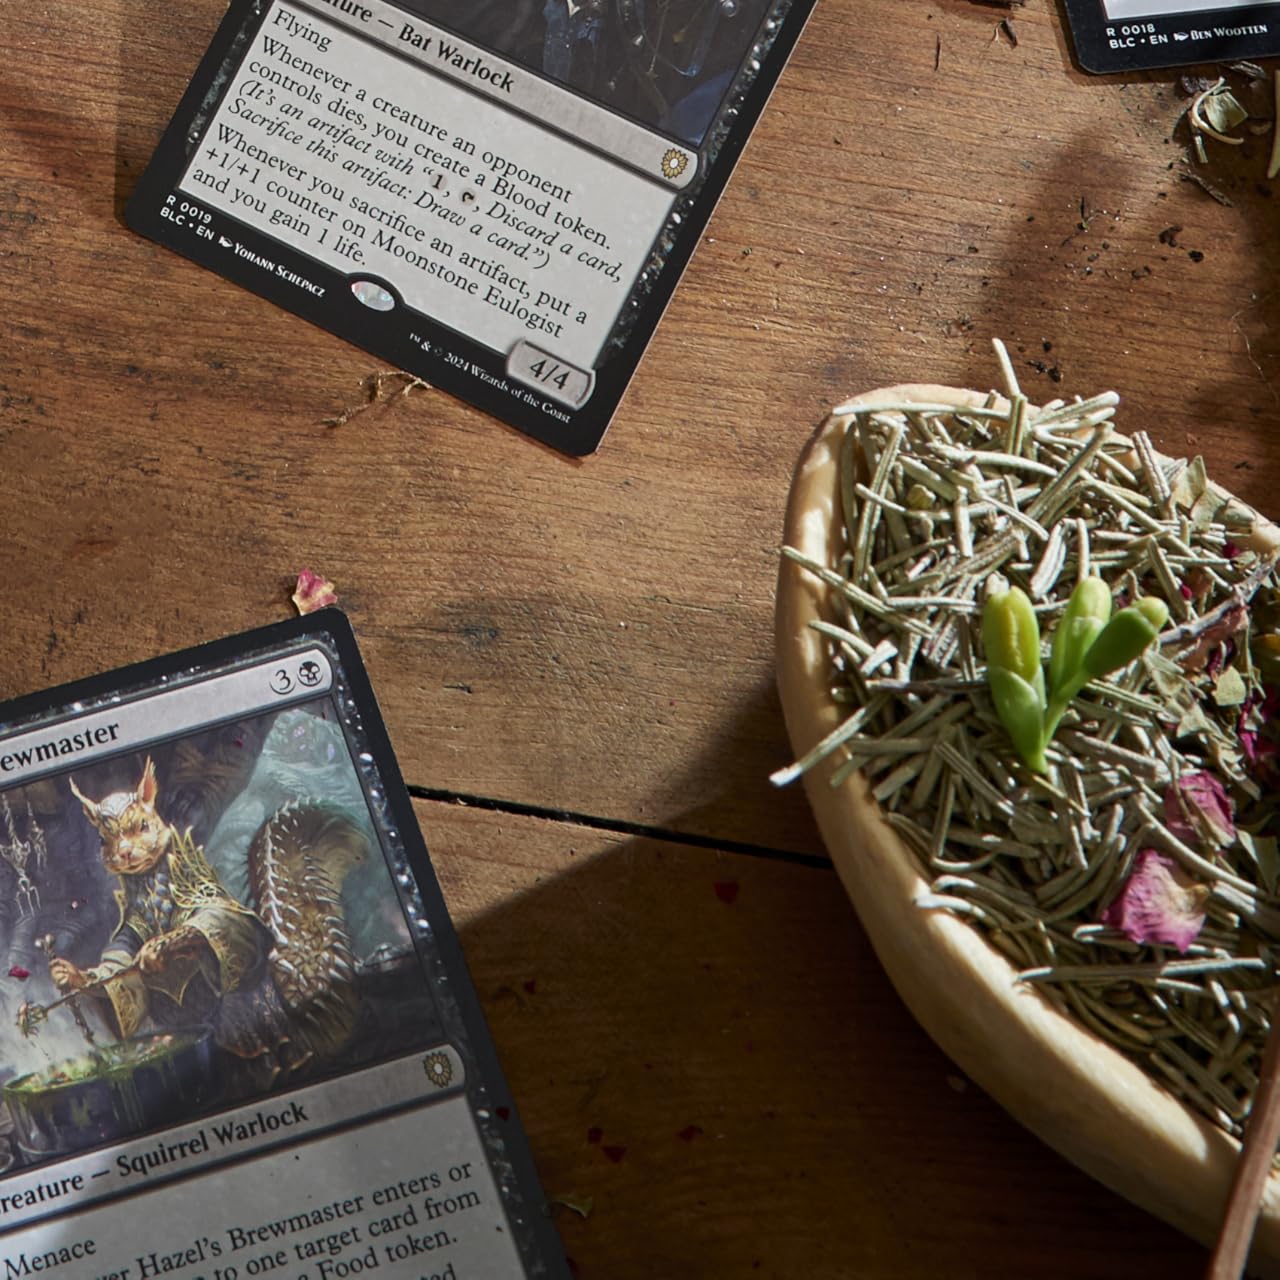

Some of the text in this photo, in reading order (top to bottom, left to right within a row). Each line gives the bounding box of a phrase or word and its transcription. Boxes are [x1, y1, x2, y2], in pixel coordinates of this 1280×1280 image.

[271, 7, 332, 53] Flying
[397, 22, 432, 51] Bat
[437, 39, 514, 93] Warlock
[1105, 23, 1155, 36] R 0018
[1109, 24, 1268, 49] BLC EN BEN WOOTTEN
[263, 34, 572, 204] Whenever a creature an opponent
[165, 194, 212, 224] R 0019
[159, 206, 325, 297] BLC EN YOHANN SCHEPACZ
[529, 359, 570, 390] 4/4
[116, 1129, 209, 1177] Squirrel
[210, 1101, 309, 1145] Warlock
[225, 1162, 471, 1251] Brewmaster enters or
[293, 1191, 481, 1261] target card from
[384, 1230, 457, 1263] token.
